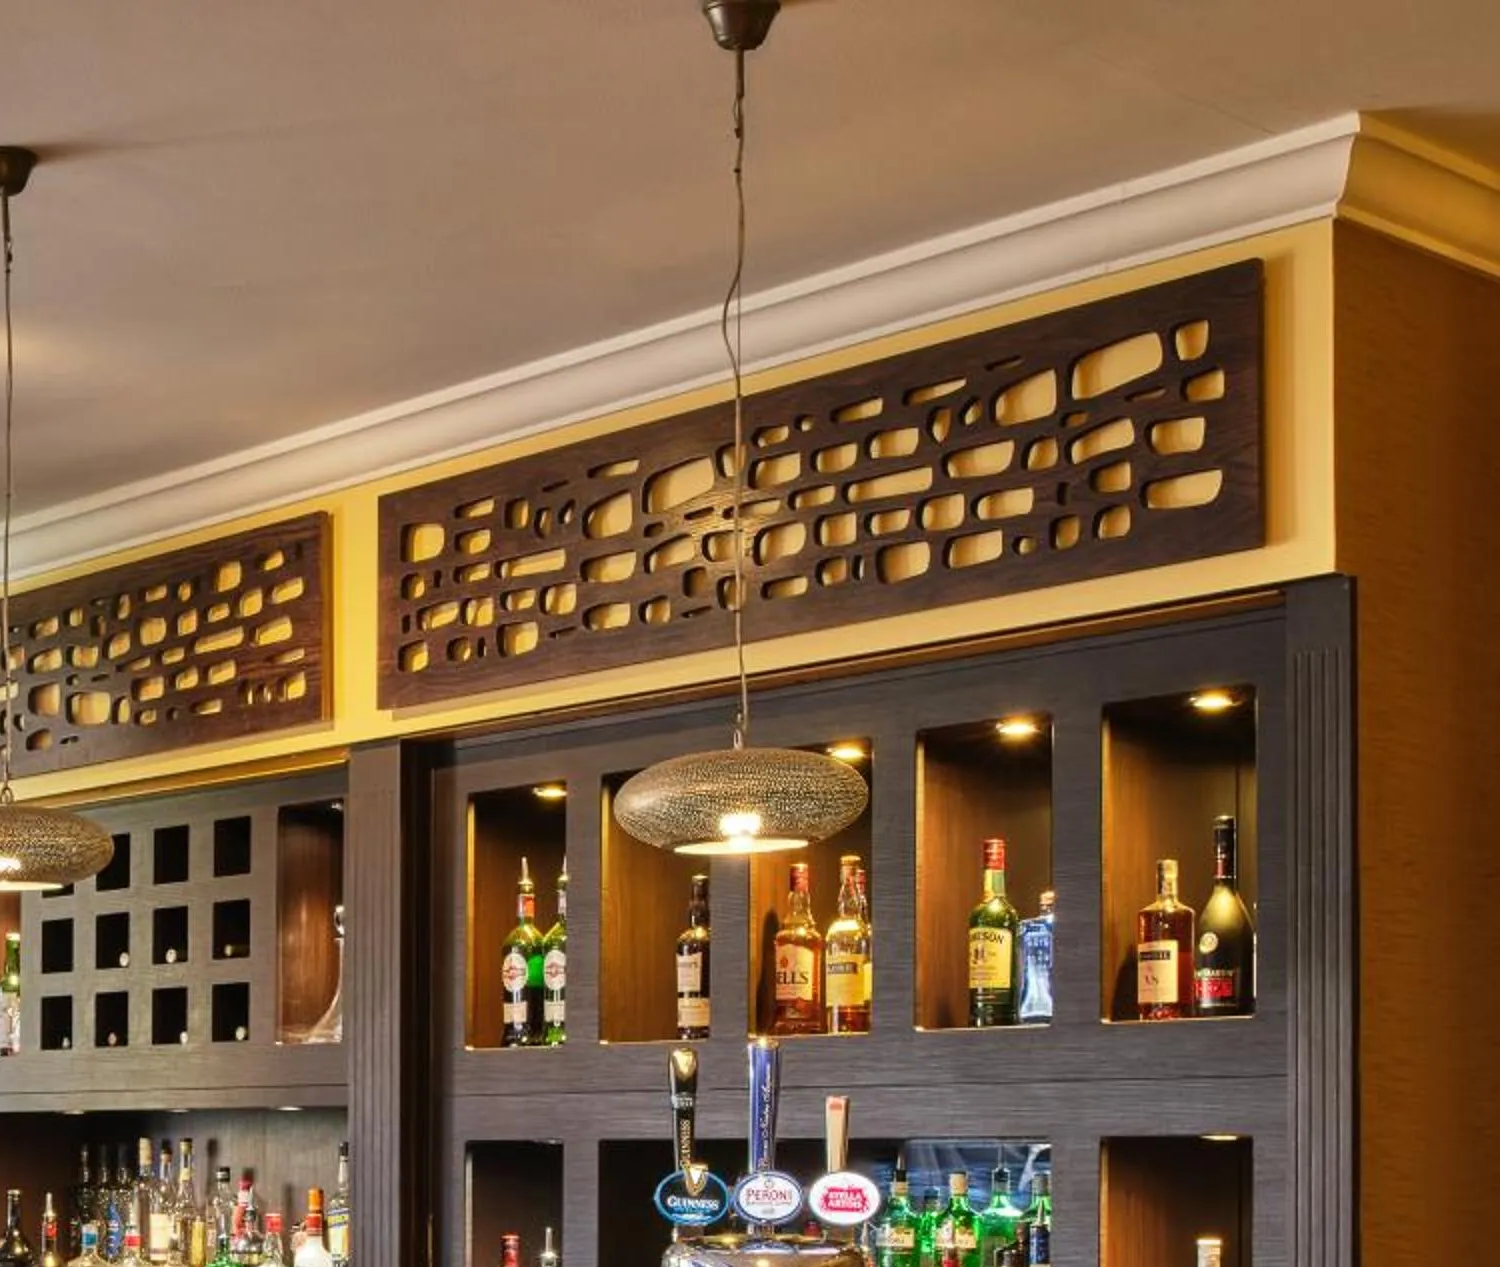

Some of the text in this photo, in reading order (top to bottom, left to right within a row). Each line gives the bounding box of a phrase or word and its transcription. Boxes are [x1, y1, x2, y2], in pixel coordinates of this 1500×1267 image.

[746, 1188, 794, 1202] PERONI
[828, 1190, 863, 1201] STELLA
[666, 1195, 720, 1211] GUINNESS
